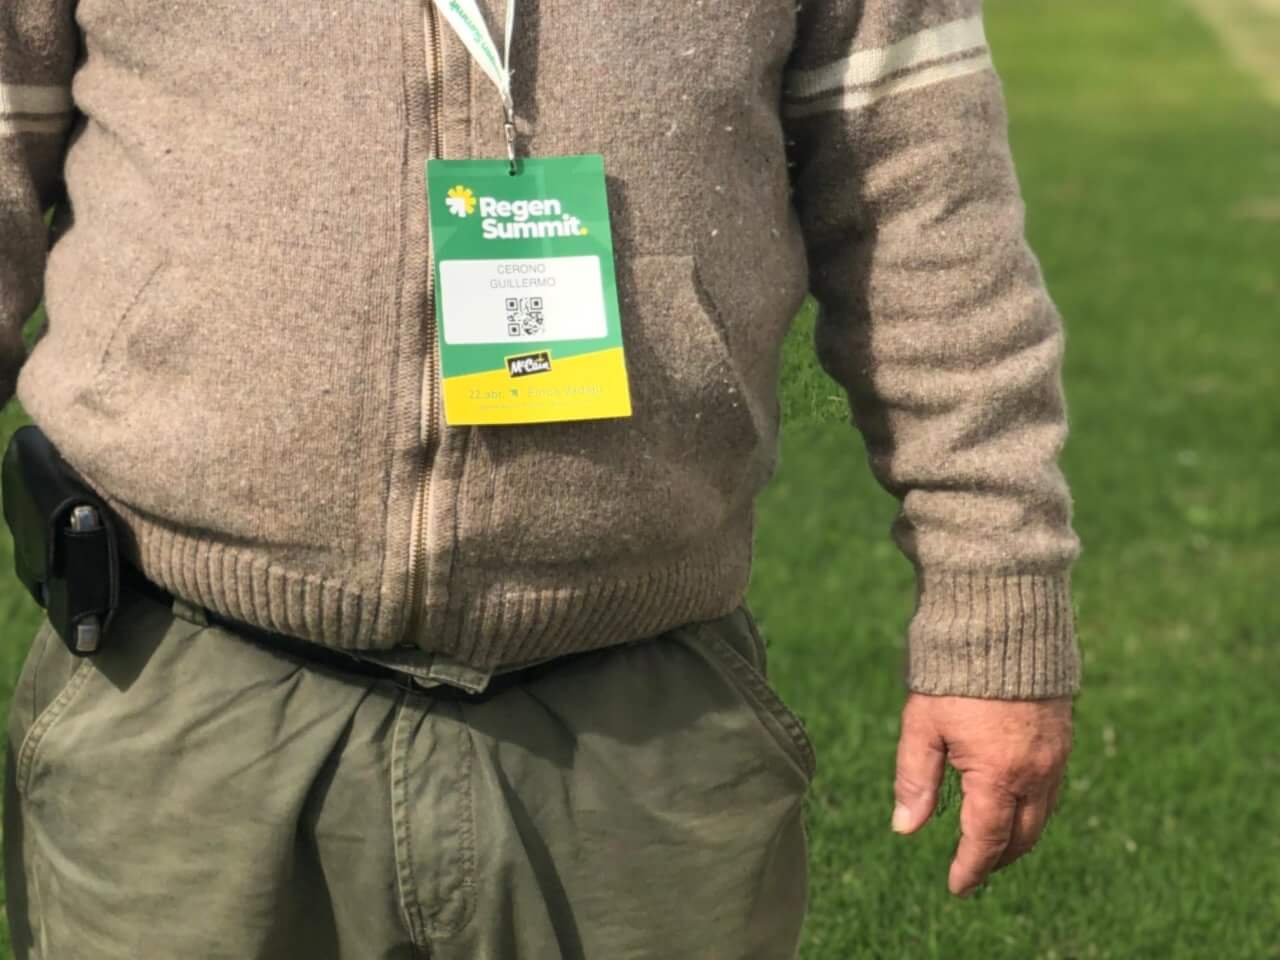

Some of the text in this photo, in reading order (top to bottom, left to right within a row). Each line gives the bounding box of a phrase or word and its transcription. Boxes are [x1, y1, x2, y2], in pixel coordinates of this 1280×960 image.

[479, 197, 561, 221] Regen
[483, 214, 588, 239] Summit.
[497, 263, 547, 274] CERONO
[490, 276, 556, 289] GUILLERMO
